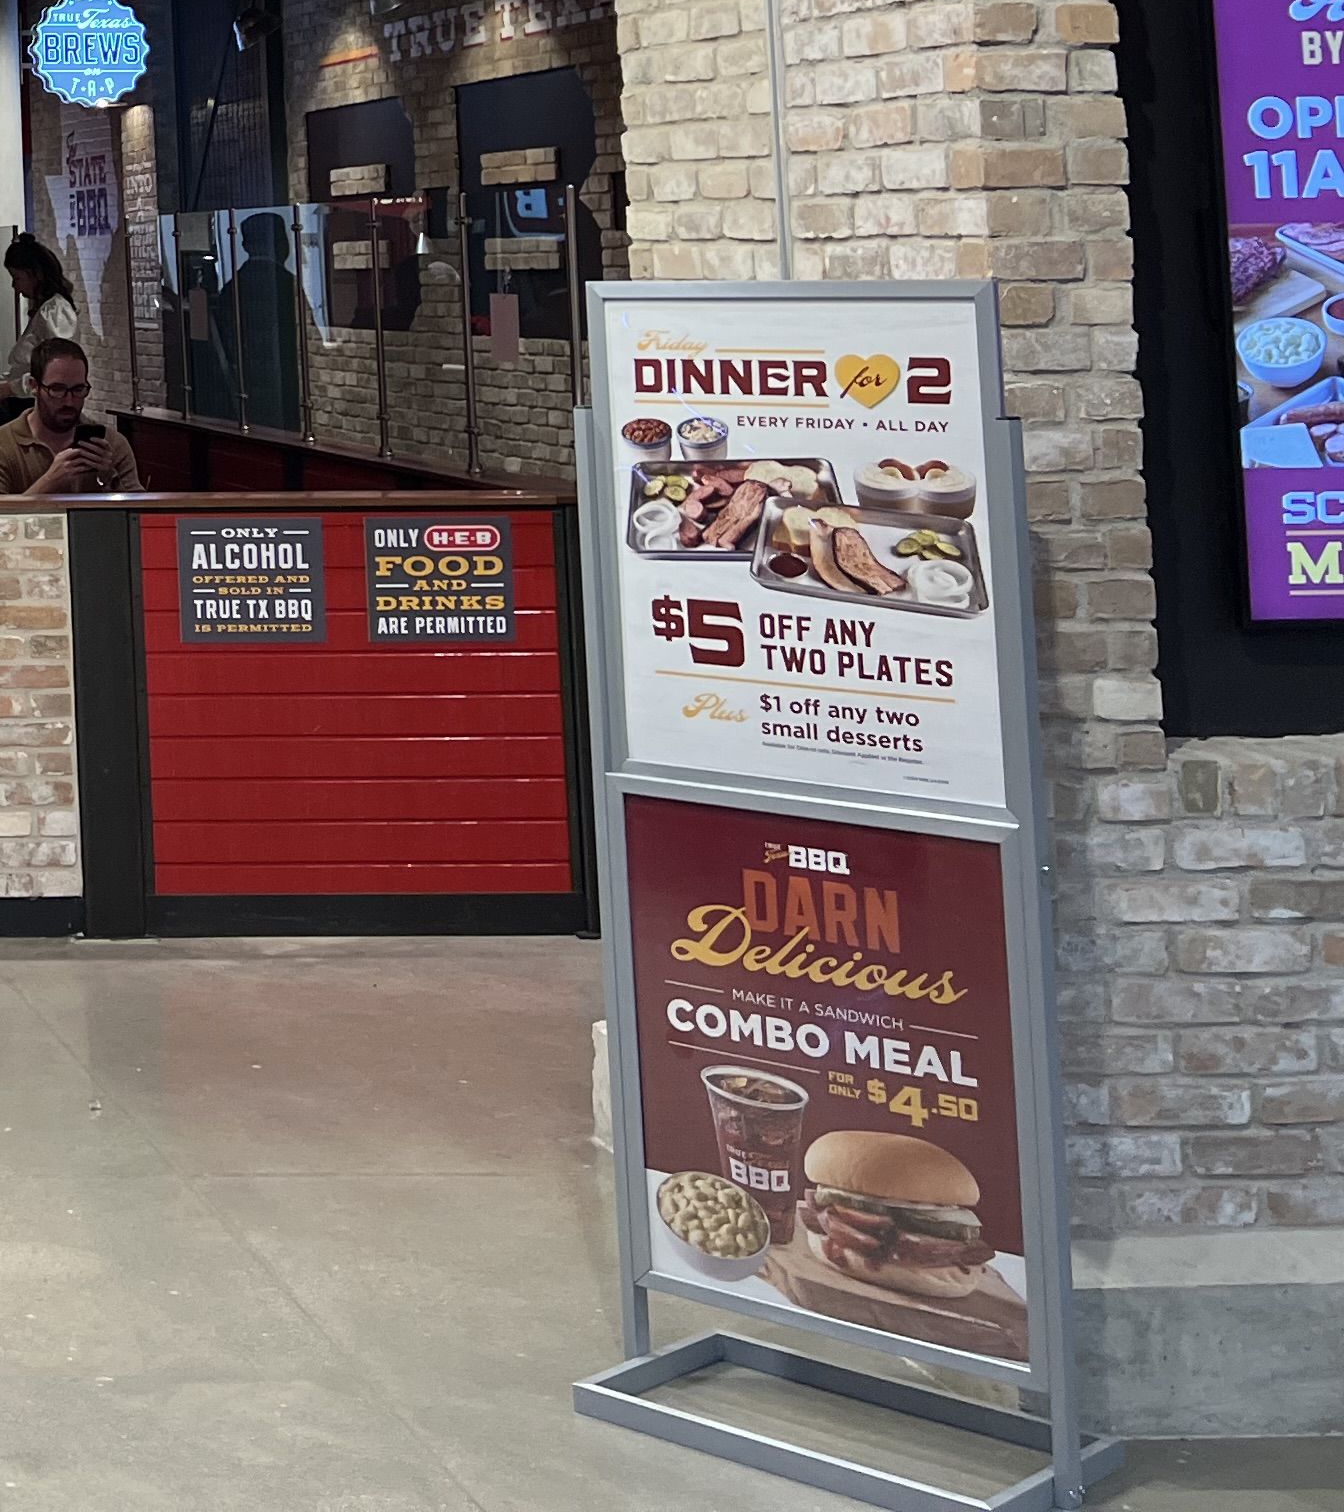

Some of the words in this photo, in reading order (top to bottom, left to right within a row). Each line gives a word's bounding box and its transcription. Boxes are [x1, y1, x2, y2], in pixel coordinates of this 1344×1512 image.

[77, 8, 131, 29] Texas
[383, 1, 487, 63] TRUE
[43, 33, 140, 65] BREWS
[637, 328, 709, 356] Friday
[633, 357, 830, 398] DINNER
[840, 366, 889, 399] for
[906, 357, 952, 405] 2
[736, 415, 789, 429] EVERY
[796, 416, 855, 430] FRIDAY
[876, 419, 909, 432] ALL
[915, 420, 950, 433] DAY
[221, 527, 278, 539] ONLY
[374, 529, 419, 549] ONLY
[192, 543, 309, 570] ALCOHOL
[375, 555, 504, 578] FOOD
[192, 576, 269, 584] OFFERED
[274, 575, 310, 584] AND
[218, 587, 264, 595] SOLD
[266, 586, 284, 595] IN
[413, 579, 467, 591] AND
[194, 599, 241, 620] TRUE
[246, 599, 269, 620] TX
[275, 599, 312, 621] BBQ
[375, 595, 505, 611] DRINKS
[194, 624, 212, 633] IS
[216, 624, 313, 633] PERMITTED
[377, 617, 409, 635] ARE
[415, 616, 507, 634] PERMITTED
[651, 594, 745, 668] $5
[759, 613, 812, 642] OFF
[823, 618, 876, 648] ANY
[760, 644, 827, 675] TWO
[837, 651, 954, 688] PLATES
[682, 692, 751, 724] Plus
[759, 693, 782, 713] $1
[789, 698, 820, 717] off
[828, 705, 868, 725] any
[876, 707, 920, 728] two
[761, 720, 819, 741] small
[826, 727, 924, 753] desserts
[788, 844, 851, 876] BBQ
[741, 867, 902, 955] DARN
[670, 903, 969, 1006] Delicious
[731, 988, 776, 1009] MAKE
[780, 996, 794, 1011] IT
[798, 1000, 811, 1014] A
[814, 1003, 905, 1032] SANDWICH
[666, 998, 831, 1059] COMBO
[843, 1030, 979, 1088] MEAL
[827, 1070, 854, 1085] FOR
[827, 1083, 863, 1100] ONLY
[728, 1156, 791, 1193] BBQ
